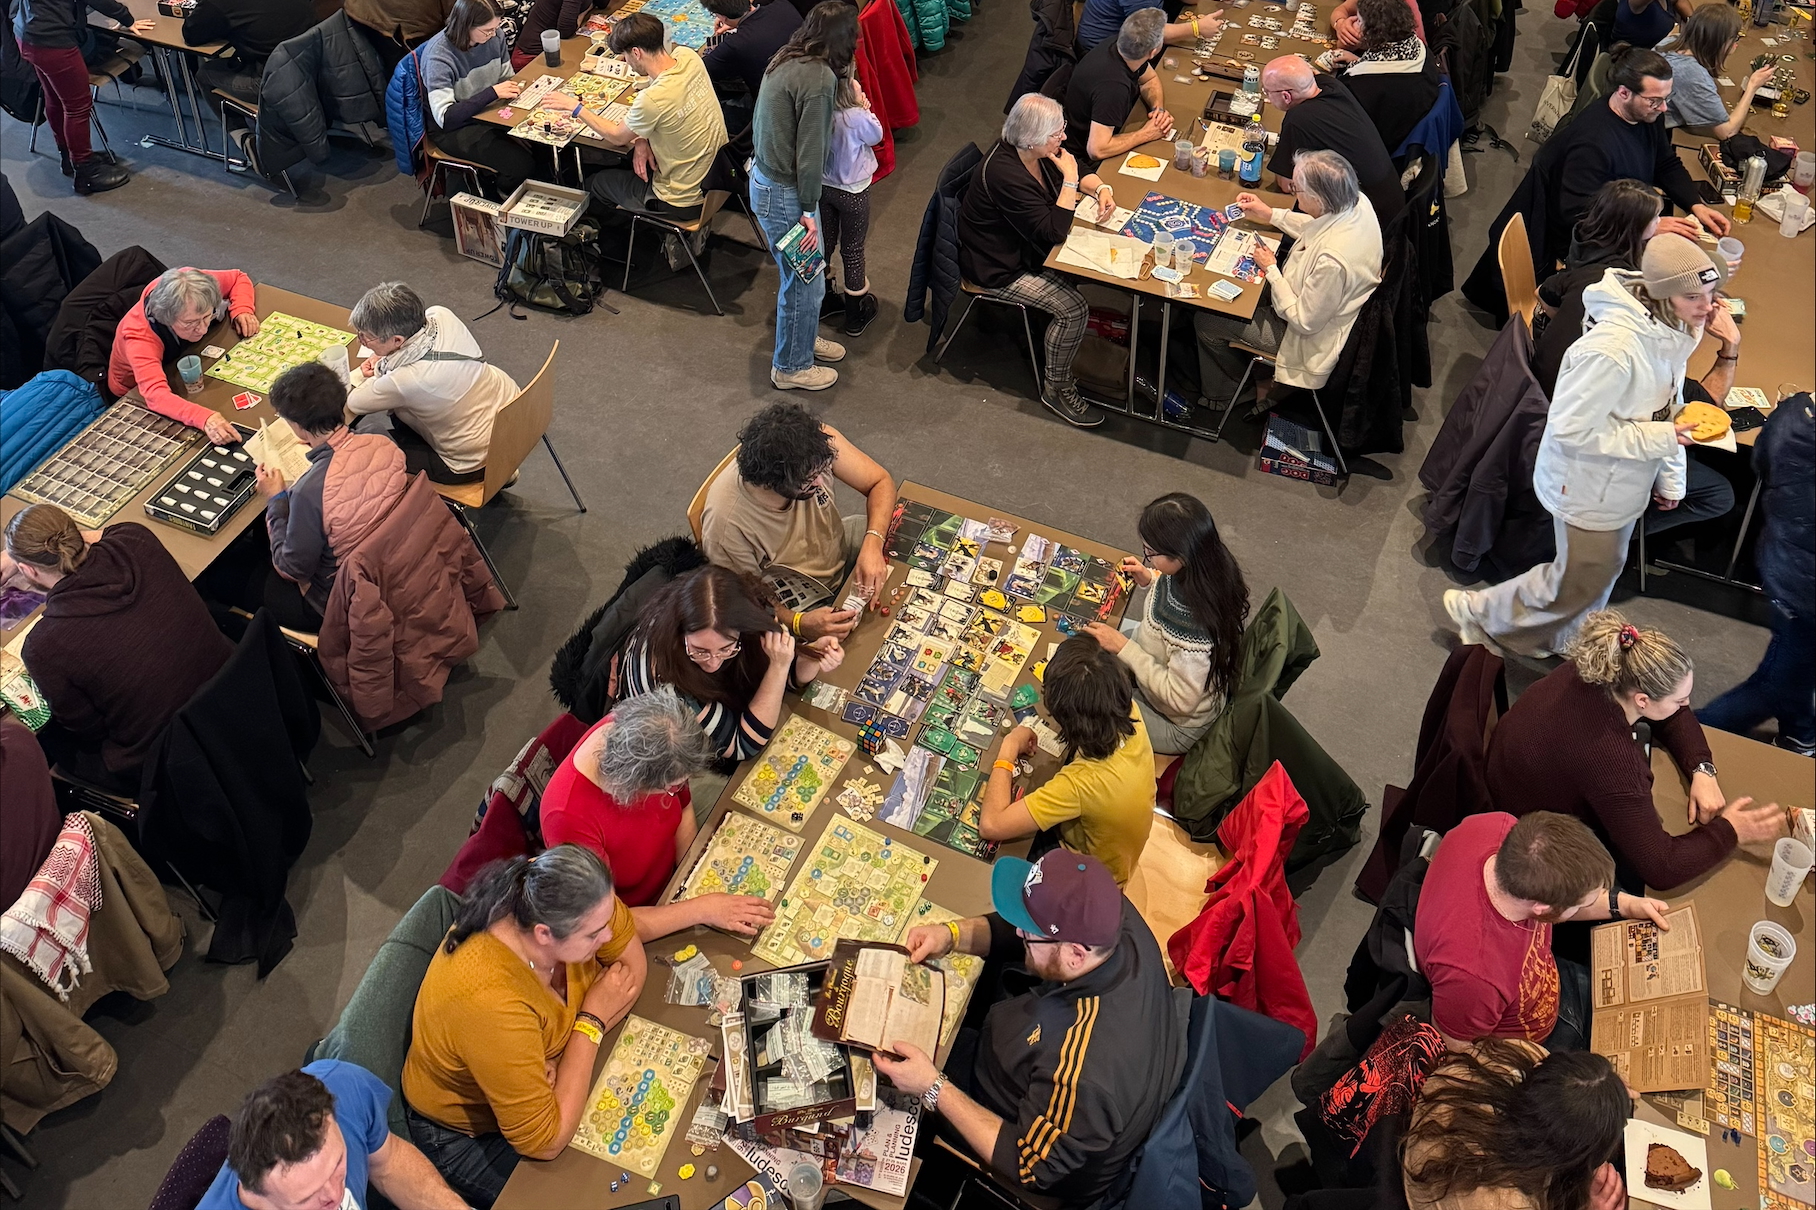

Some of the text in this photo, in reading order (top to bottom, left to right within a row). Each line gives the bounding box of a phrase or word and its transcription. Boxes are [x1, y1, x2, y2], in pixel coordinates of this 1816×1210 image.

[1242, 161, 1253, 172] TEA
[509, 215, 553, 230] TOWER UP
[825, 958, 854, 1029] Bourgogne
[770, 1104, 840, 1127] Burgund
[895, 1095, 921, 1162] ludesco
[883, 1140, 891, 1157] PLAN
[889, 1124, 901, 1159] PLANNING
[744, 1145, 791, 1199] ludesc
[884, 1162, 906, 1175] 2026
